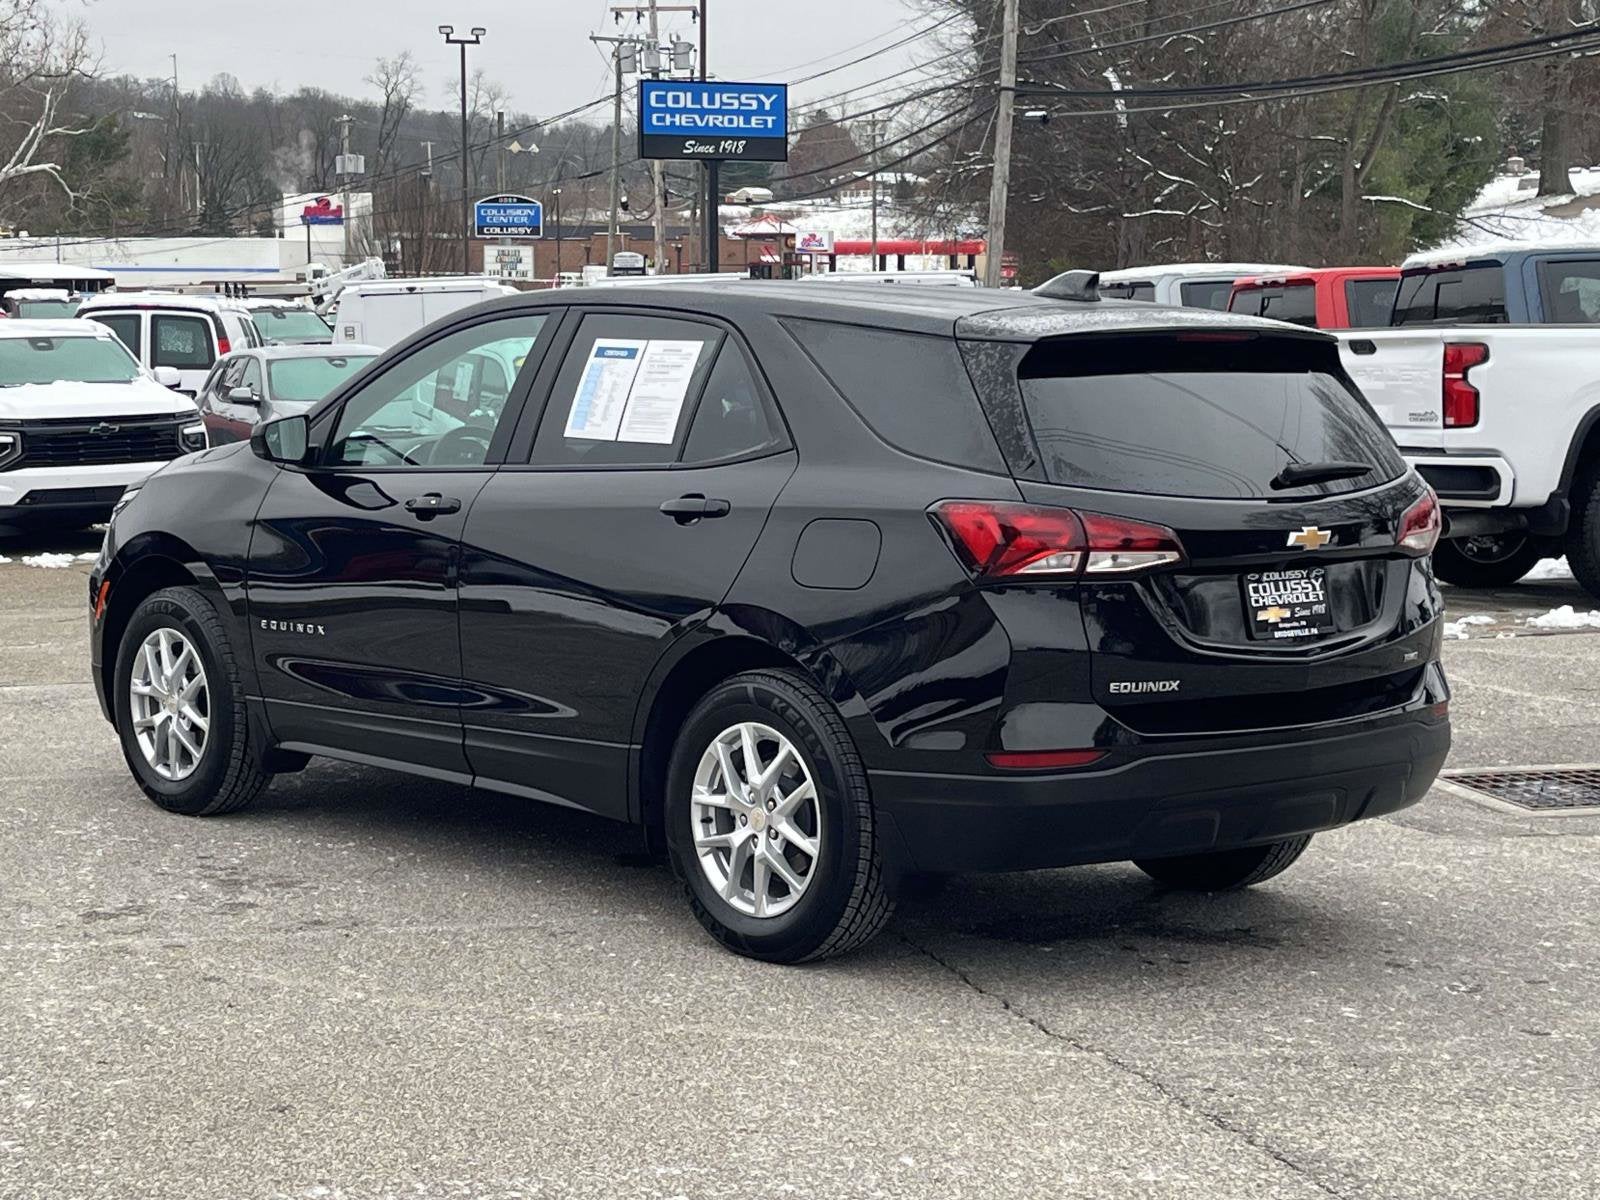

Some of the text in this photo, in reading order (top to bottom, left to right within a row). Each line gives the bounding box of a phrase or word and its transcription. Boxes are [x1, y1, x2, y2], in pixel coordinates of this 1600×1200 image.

[649, 91, 778, 110] COLUSSY
[651, 113, 777, 128] CHEVROLET
[683, 140, 746, 154] Since 1918
[480, 208, 535, 216] COLLISION
[483, 227, 533, 235] COLUSSY
[1263, 570, 1308, 581] COLUSSY
[1248, 578, 1323, 597] COLUSSY
[1250, 591, 1325, 607] CHEVROLET
[260, 619, 325, 635] EQUINOX
[1109, 680, 1181, 693] EQUINOX
[771, 697, 828, 760] KELLY
